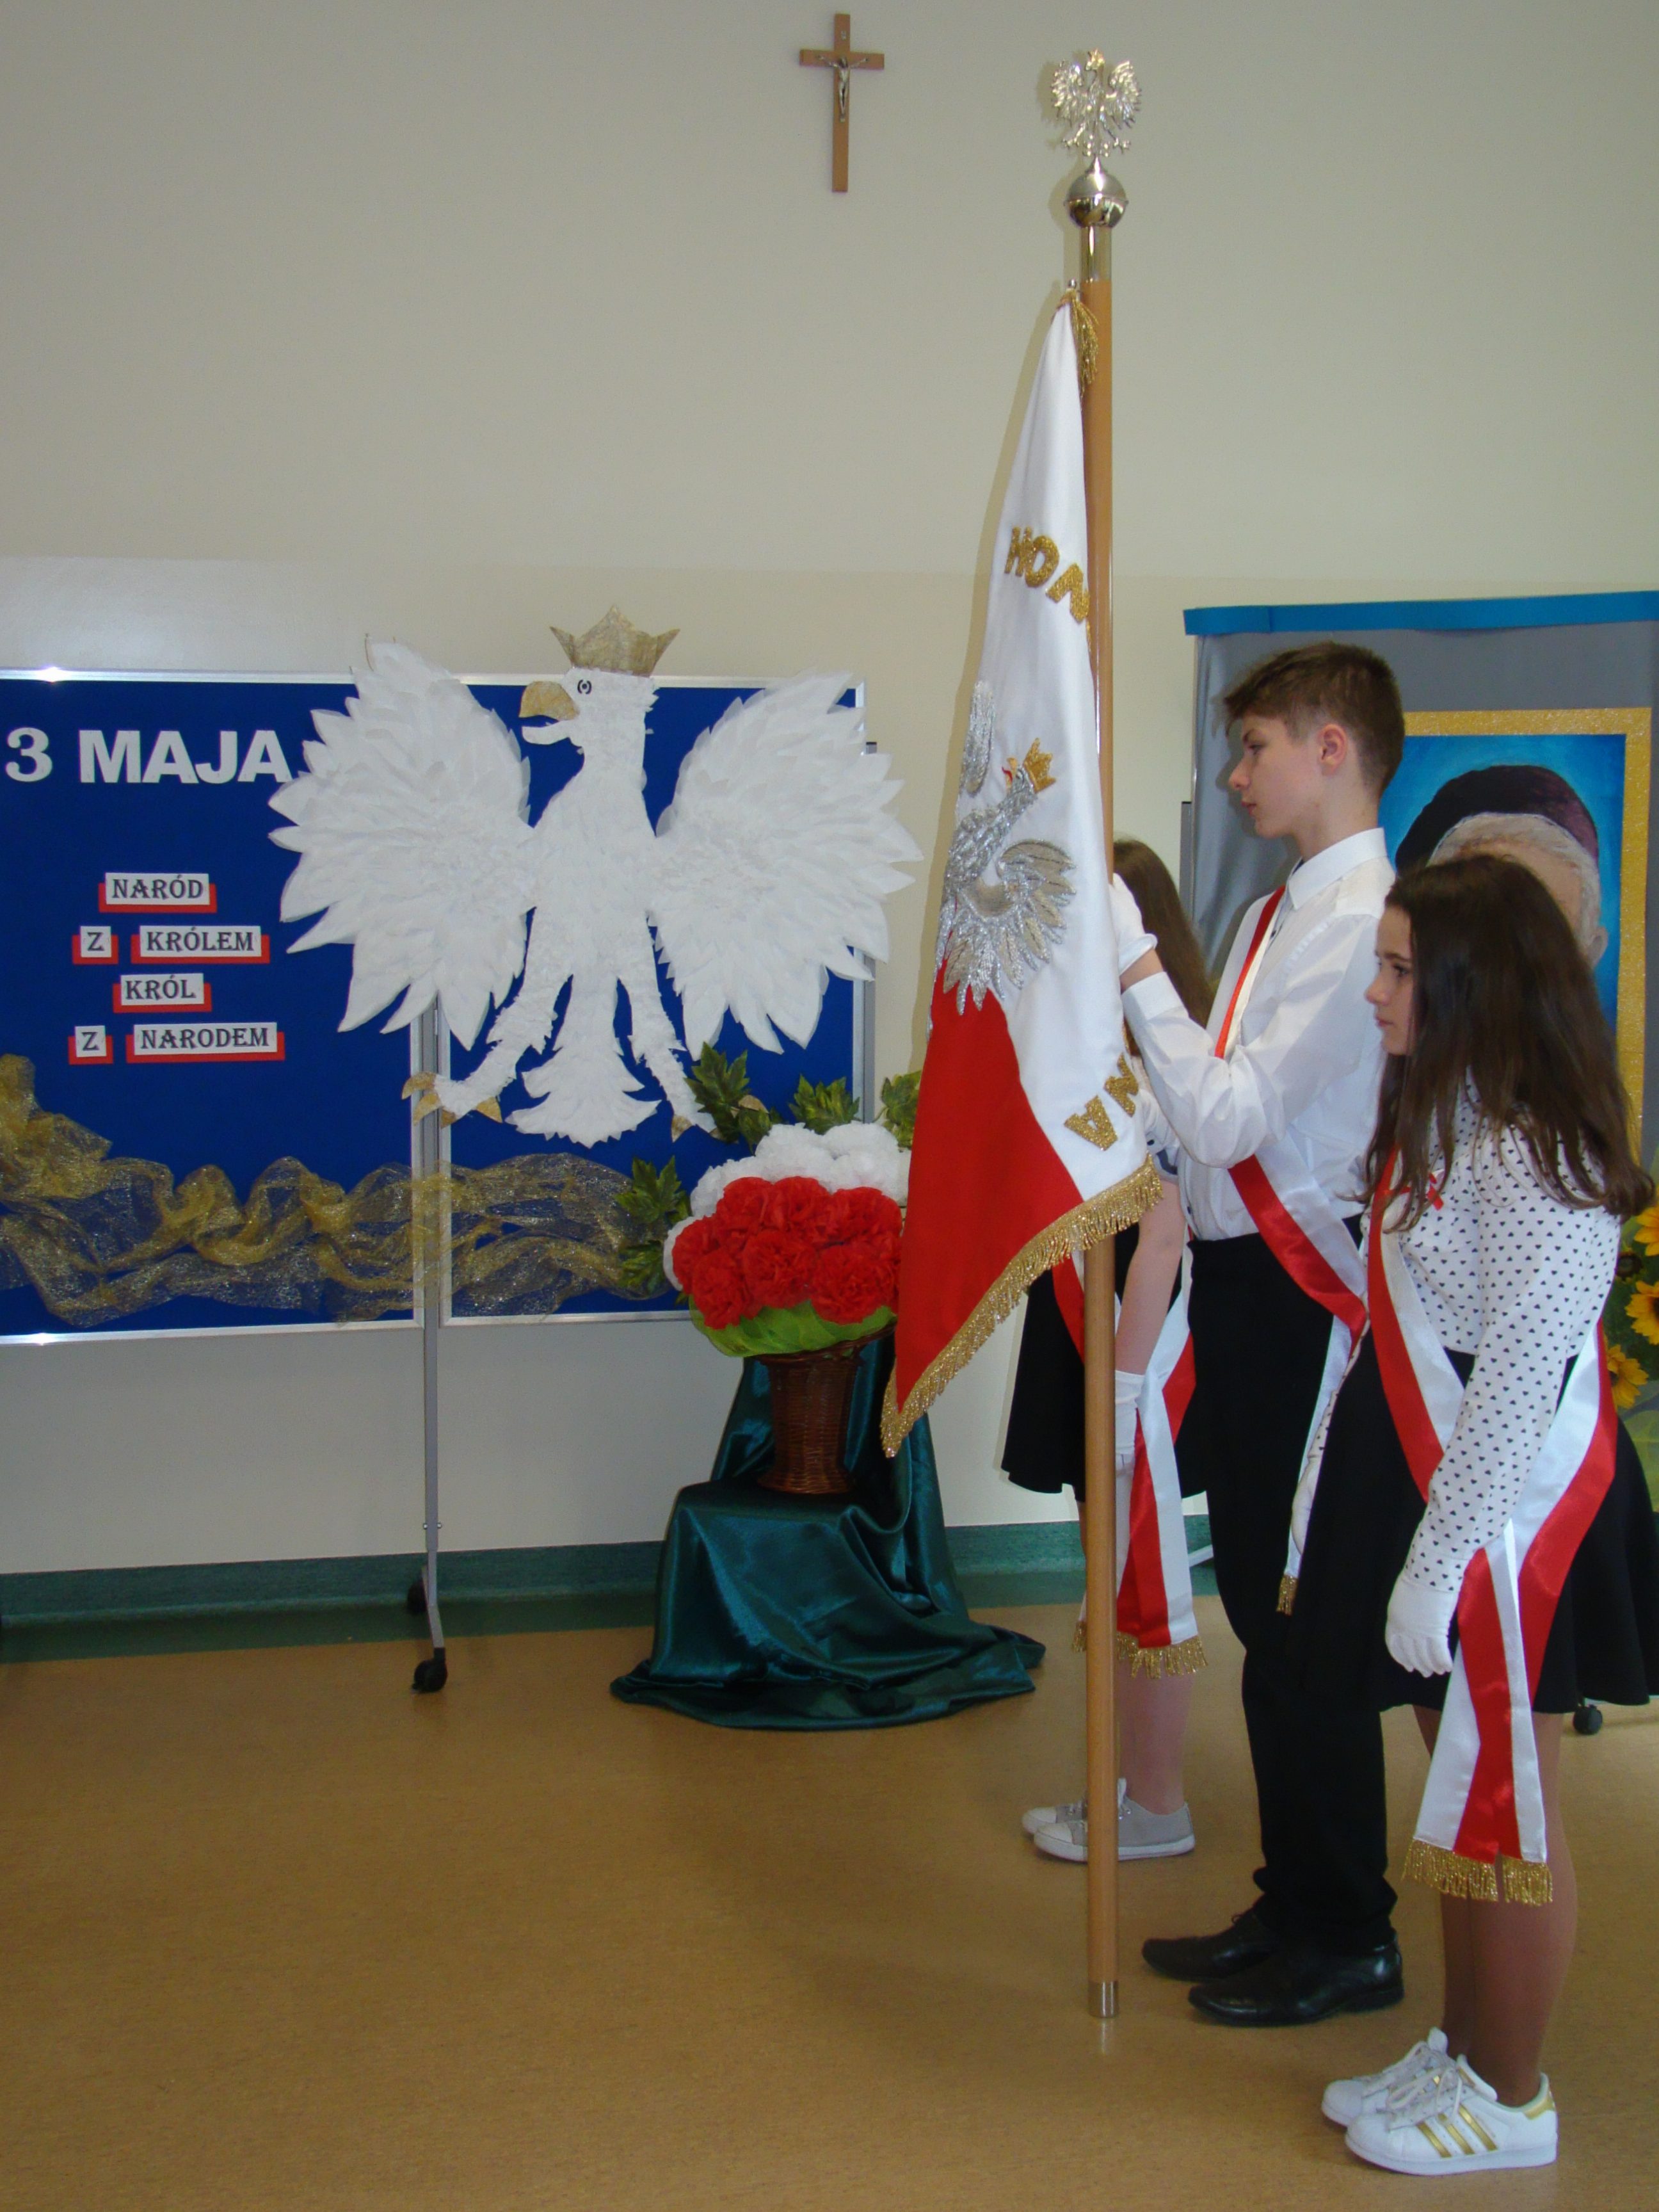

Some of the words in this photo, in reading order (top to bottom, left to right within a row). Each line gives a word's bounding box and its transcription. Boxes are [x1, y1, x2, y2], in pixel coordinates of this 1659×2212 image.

[6, 727, 52, 782] 3
[79, 730, 293, 784] MAJA
[112, 875, 204, 900] NARÓD
[87, 932, 104, 951] Z
[147, 926, 254, 952] KRÓLEM
[125, 975, 196, 1001] KRÓL
[81, 1031, 99, 1051] Z
[141, 1027, 269, 1049] NARODEM
